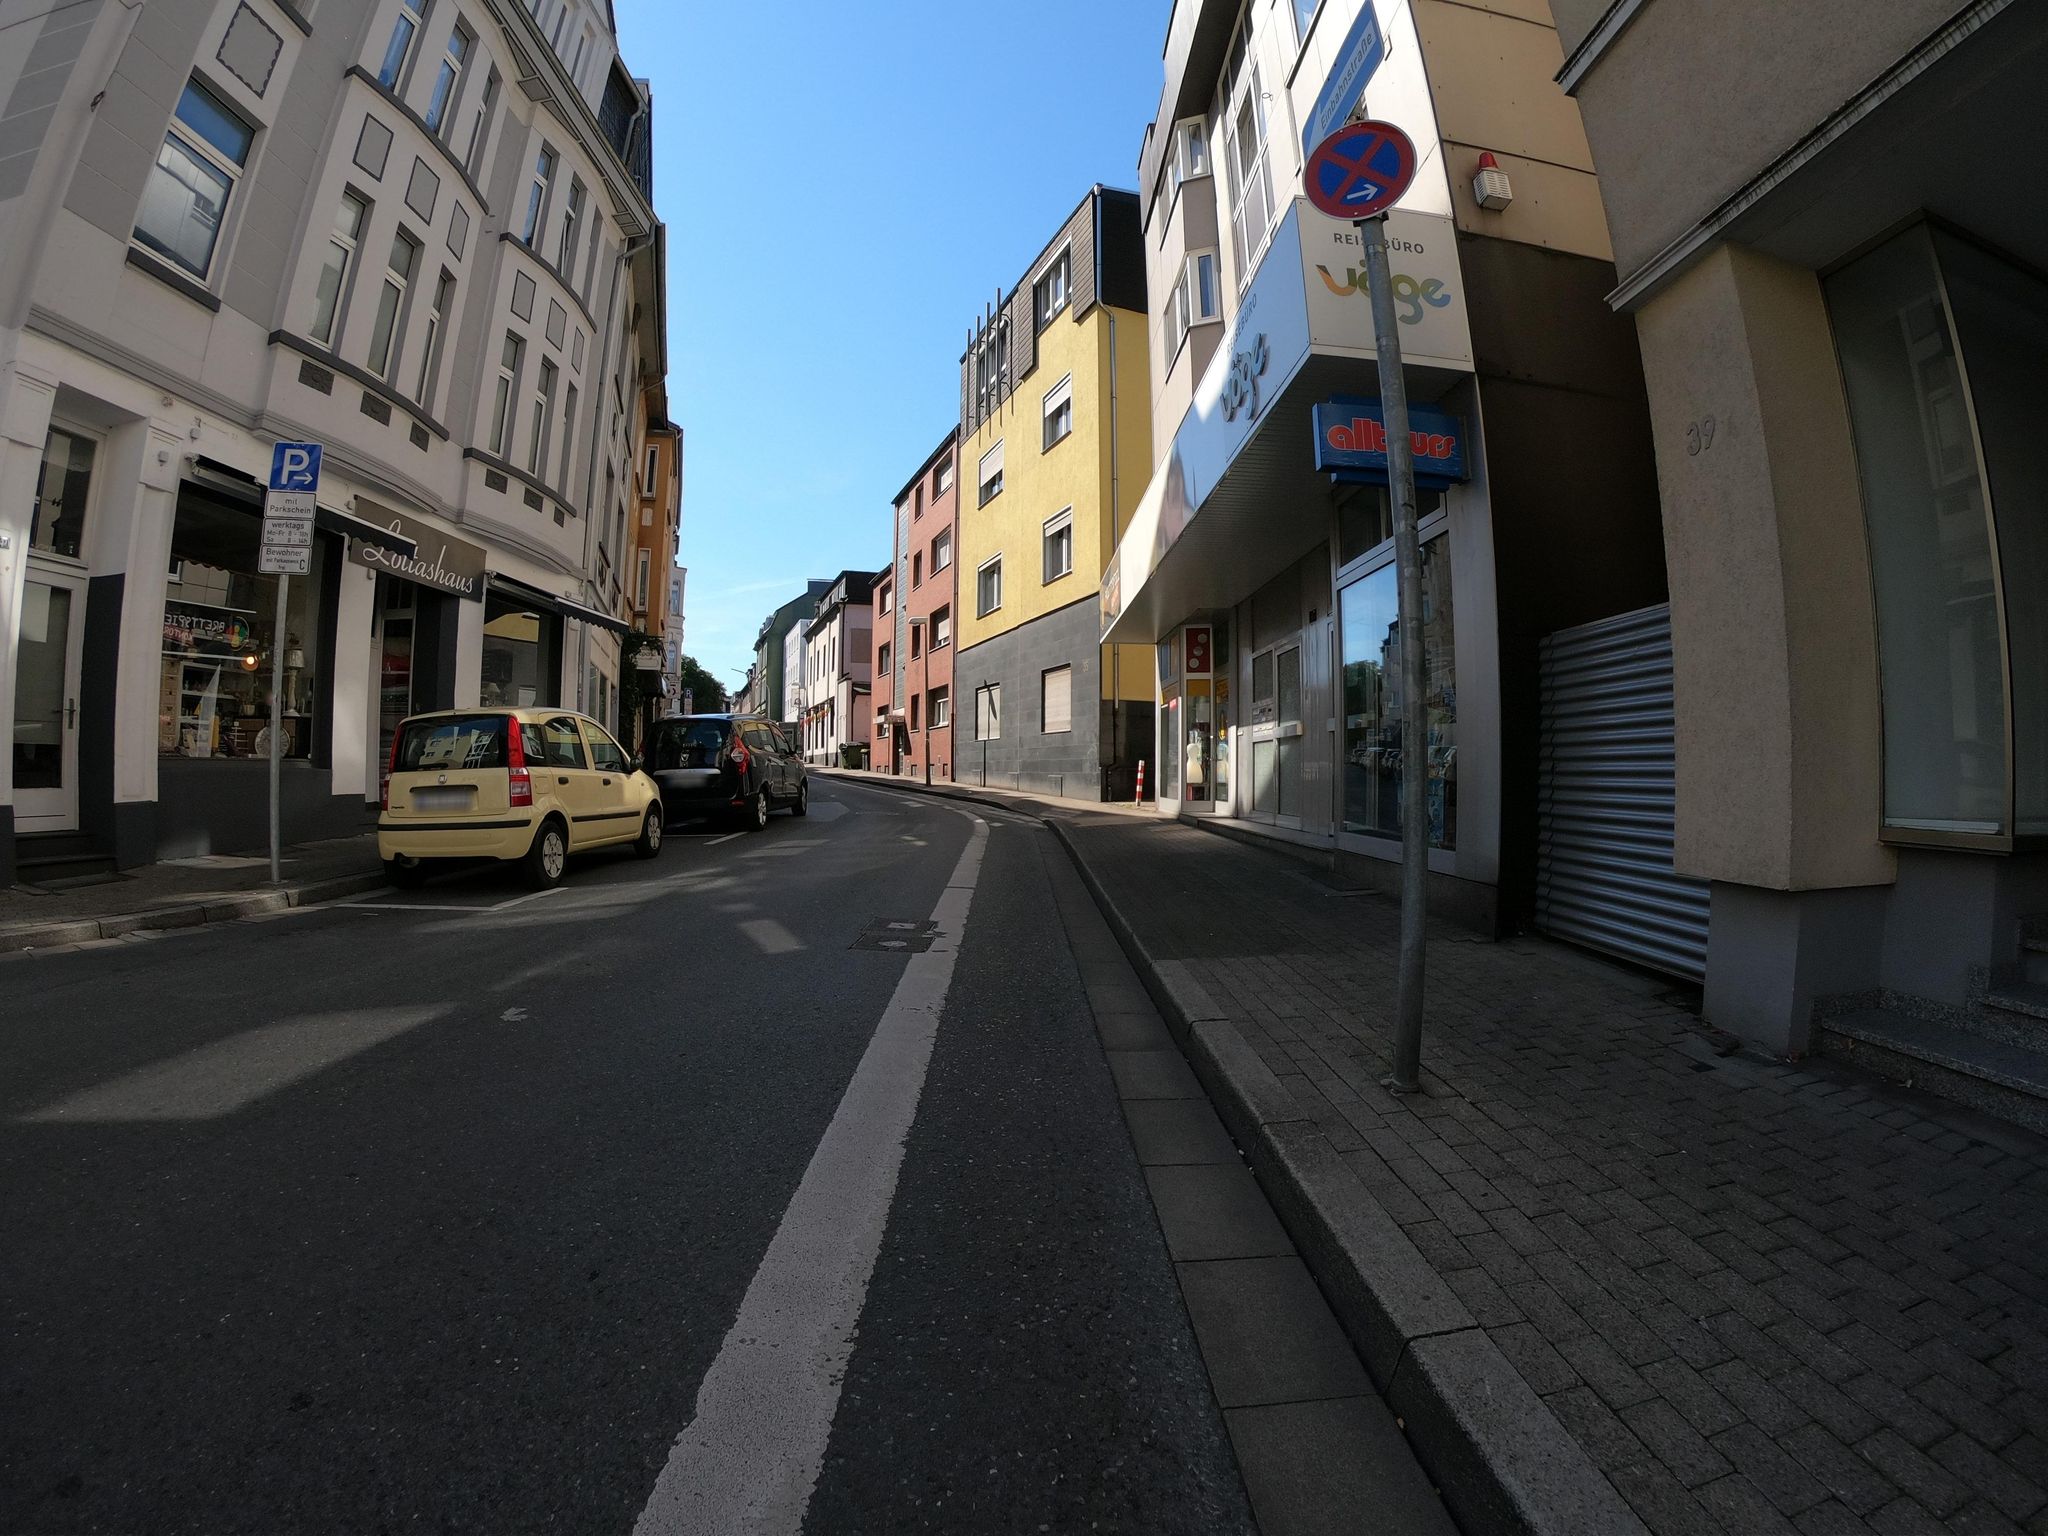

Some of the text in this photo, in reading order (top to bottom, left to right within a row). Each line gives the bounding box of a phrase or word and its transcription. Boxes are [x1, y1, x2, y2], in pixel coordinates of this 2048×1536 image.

[1320, 32, 1373, 129] Einbahnstraße
[1333, 232, 1425, 255] REIBÜRO
[1326, 417, 1456, 460] allturs
[1687, 414, 1716, 457] 39
[281, 449, 309, 484] P
[269, 505, 311, 514] Parkschein
[272, 522, 304, 530] werktags
[265, 548, 303, 557] Bewohner
[299, 559, 306, 571] C
